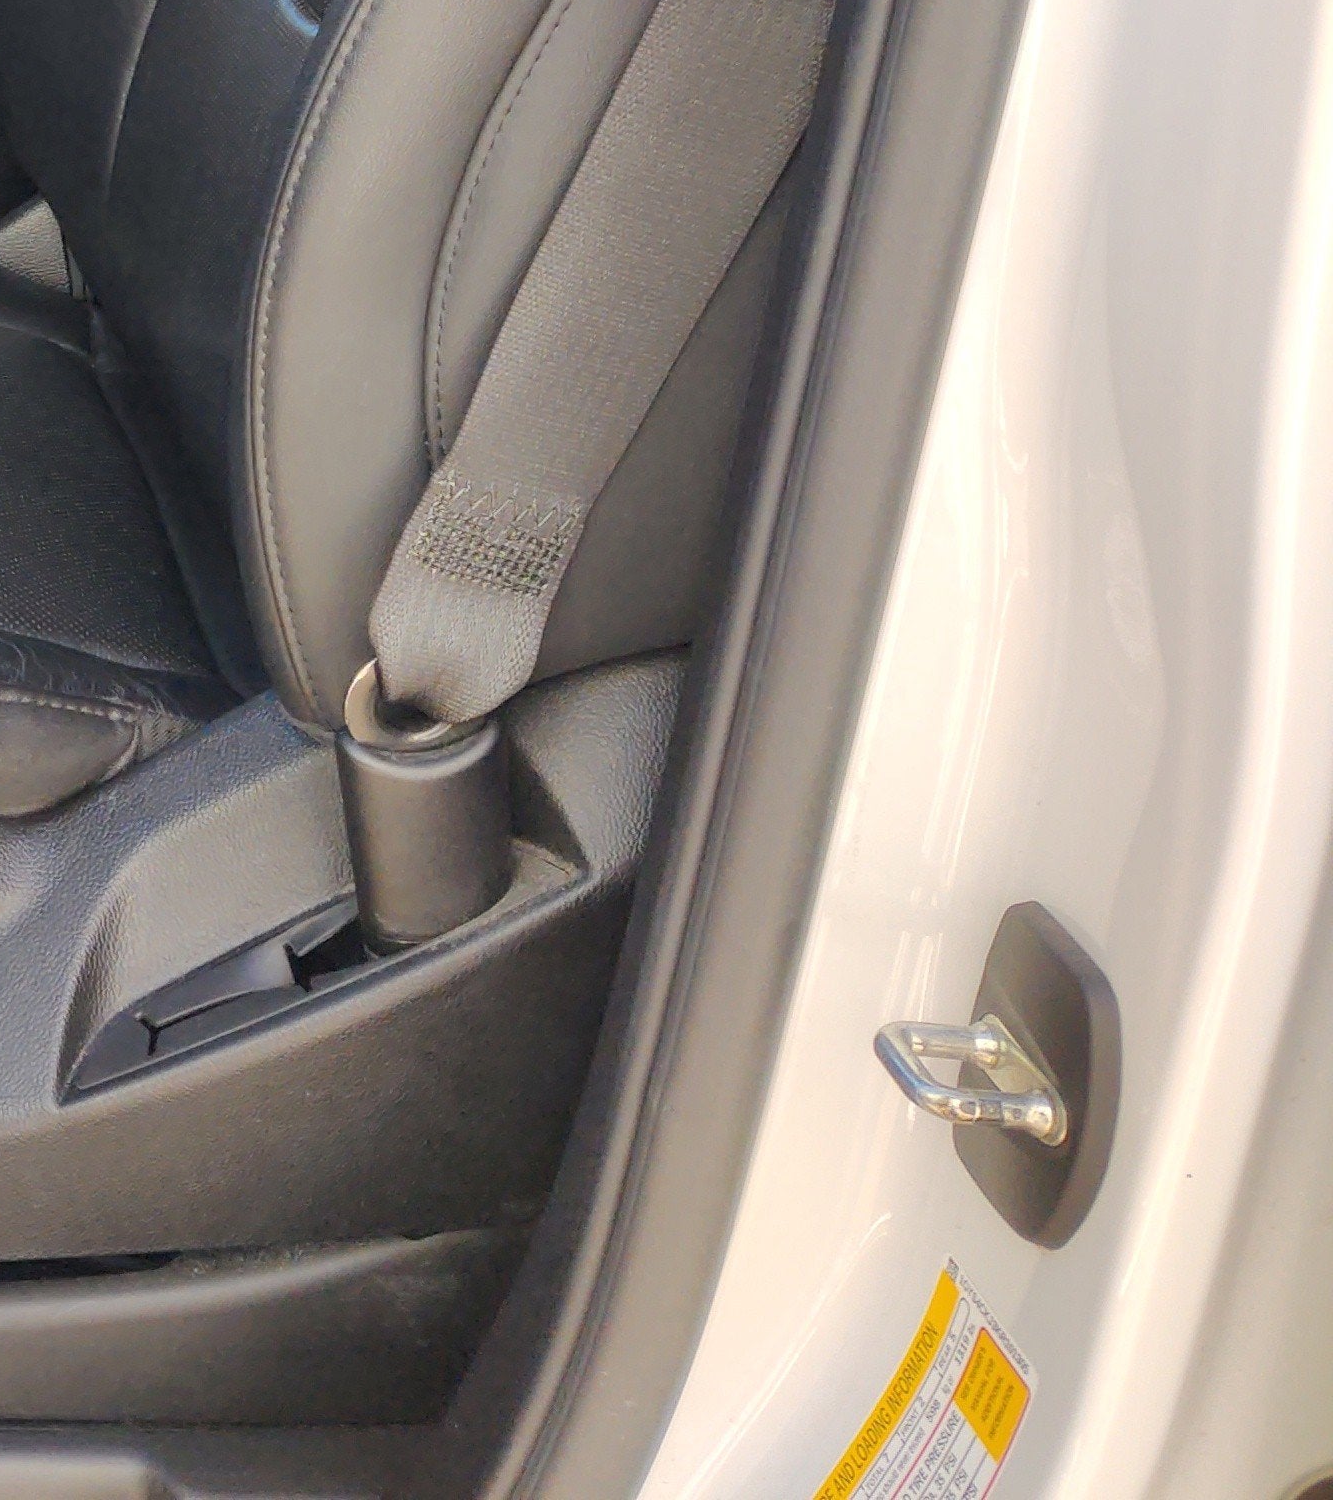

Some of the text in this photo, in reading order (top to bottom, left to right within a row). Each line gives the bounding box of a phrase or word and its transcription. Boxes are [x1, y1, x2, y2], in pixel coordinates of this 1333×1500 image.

[938, 1344, 952, 1368] REAR
[833, 1461, 856, 1496] AND
[851, 1407, 893, 1469] LOADING
[886, 1324, 939, 1415] INFORMATION
[900, 1395, 926, 1436] FRONT 2
[882, 1451, 891, 1464] 7
[908, 1466, 929, 1496] TIRE
[924, 1408, 962, 1472] PRESSURE
[934, 1452, 957, 1491] 35 PSI
[954, 1467, 969, 1491] PSI
